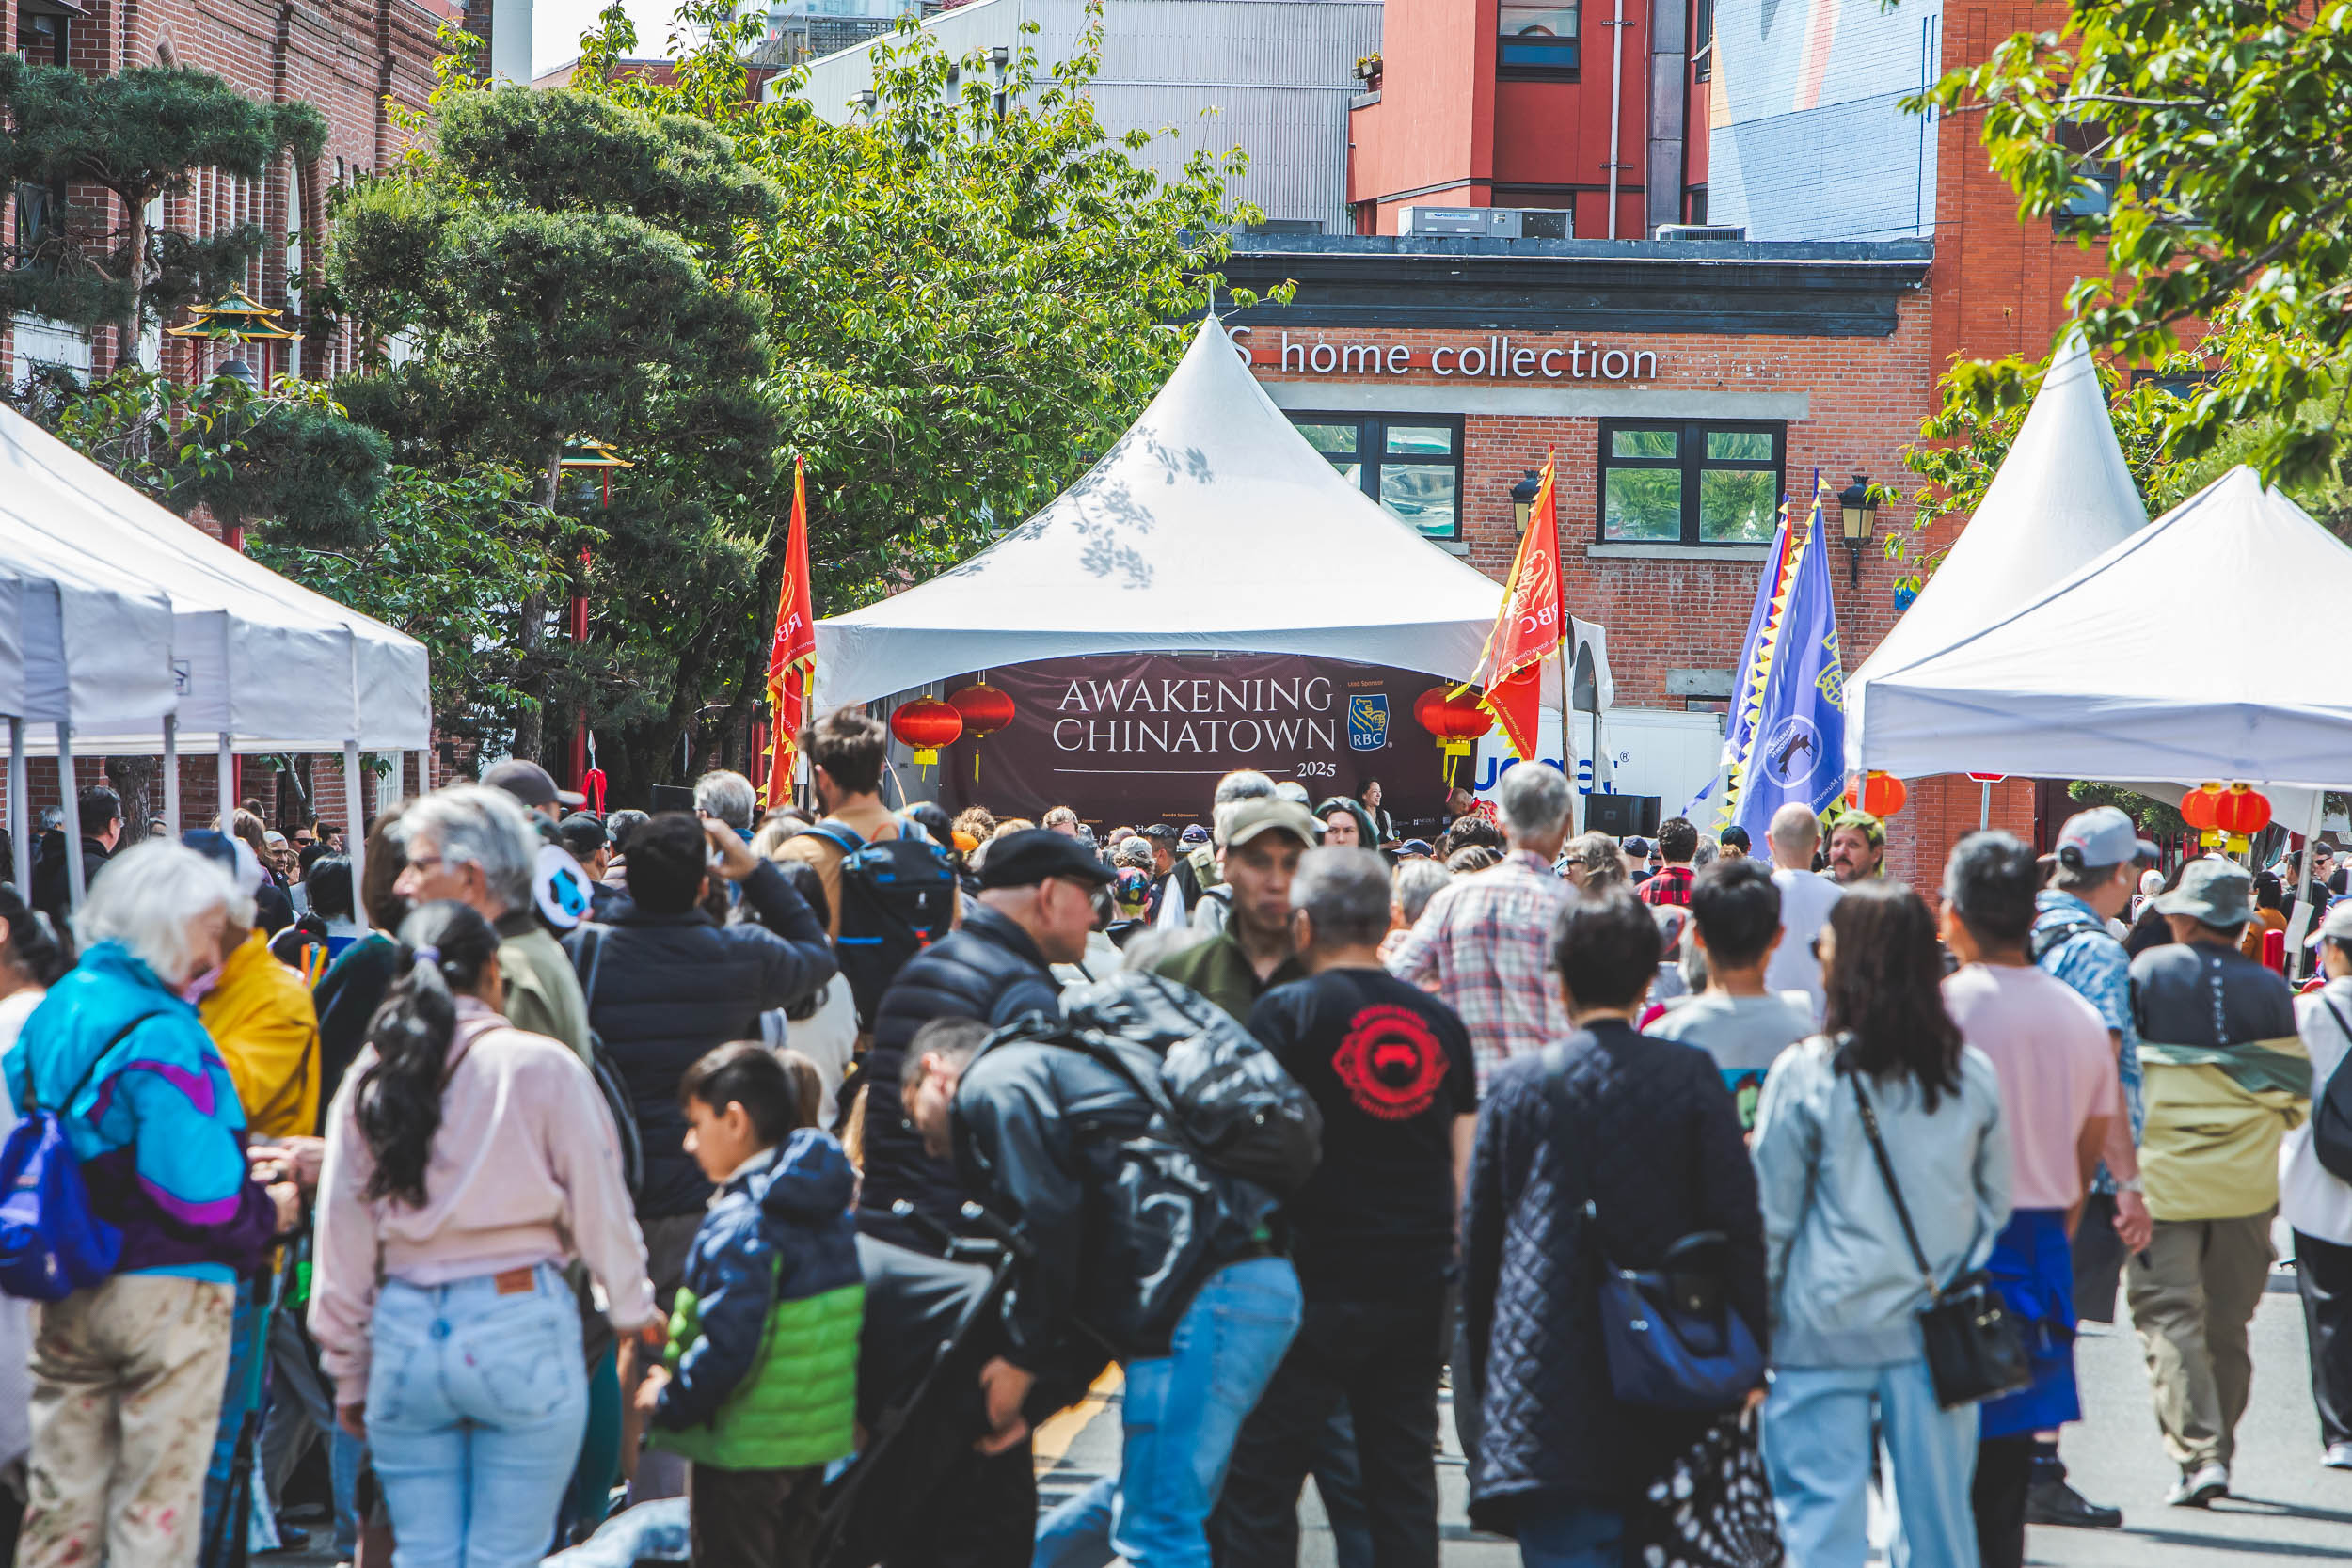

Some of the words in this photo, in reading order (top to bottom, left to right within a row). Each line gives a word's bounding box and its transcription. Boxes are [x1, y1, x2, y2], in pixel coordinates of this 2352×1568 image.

[1282, 330, 1411, 374] home
[1431, 335, 1657, 380] collection
[1057, 677, 1333, 713] AWAKENING
[1053, 717, 1336, 752] CHINATOWN
[1353, 733, 1382, 746] RBC
[1296, 761, 1337, 778] 2025
